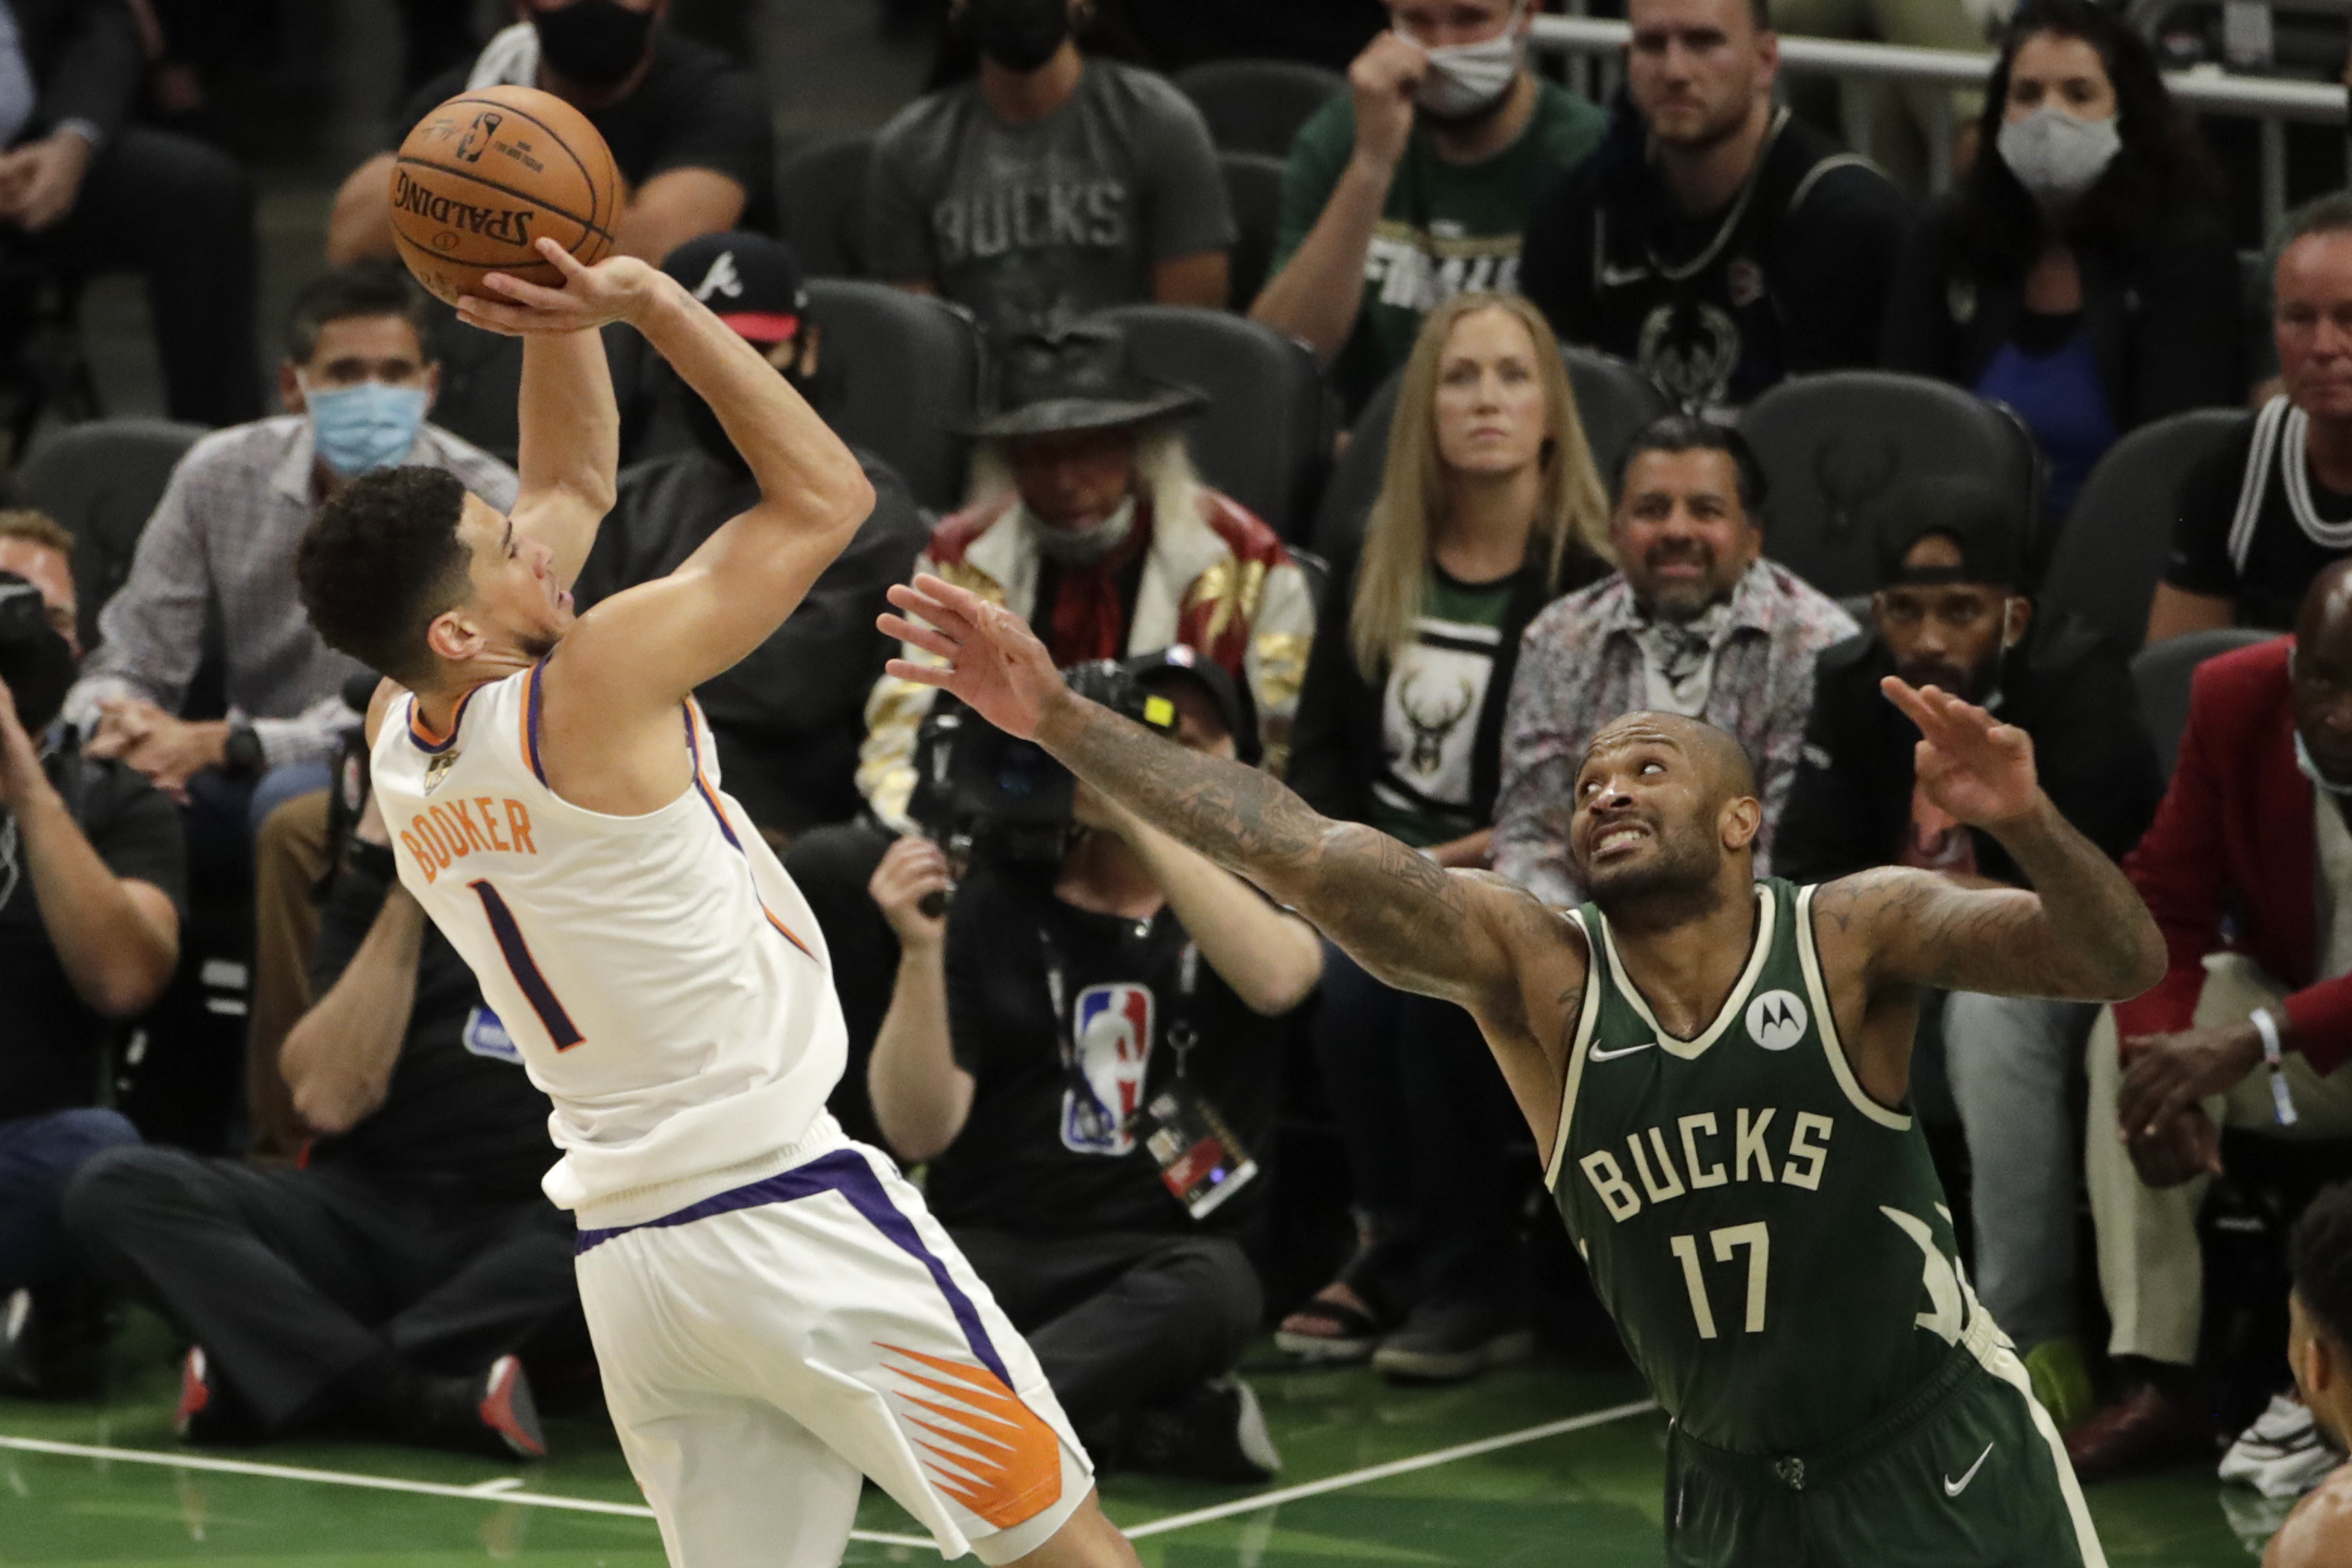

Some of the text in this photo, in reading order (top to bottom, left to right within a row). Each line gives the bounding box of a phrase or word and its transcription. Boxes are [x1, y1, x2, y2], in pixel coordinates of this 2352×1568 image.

[394, 168, 534, 247] SPALDING
[400, 797, 537, 885] BOOKER
[466, 879, 587, 1054] 1
[1579, 1107, 1834, 1224] BUCKS
[1671, 1221, 1770, 1339] 17
